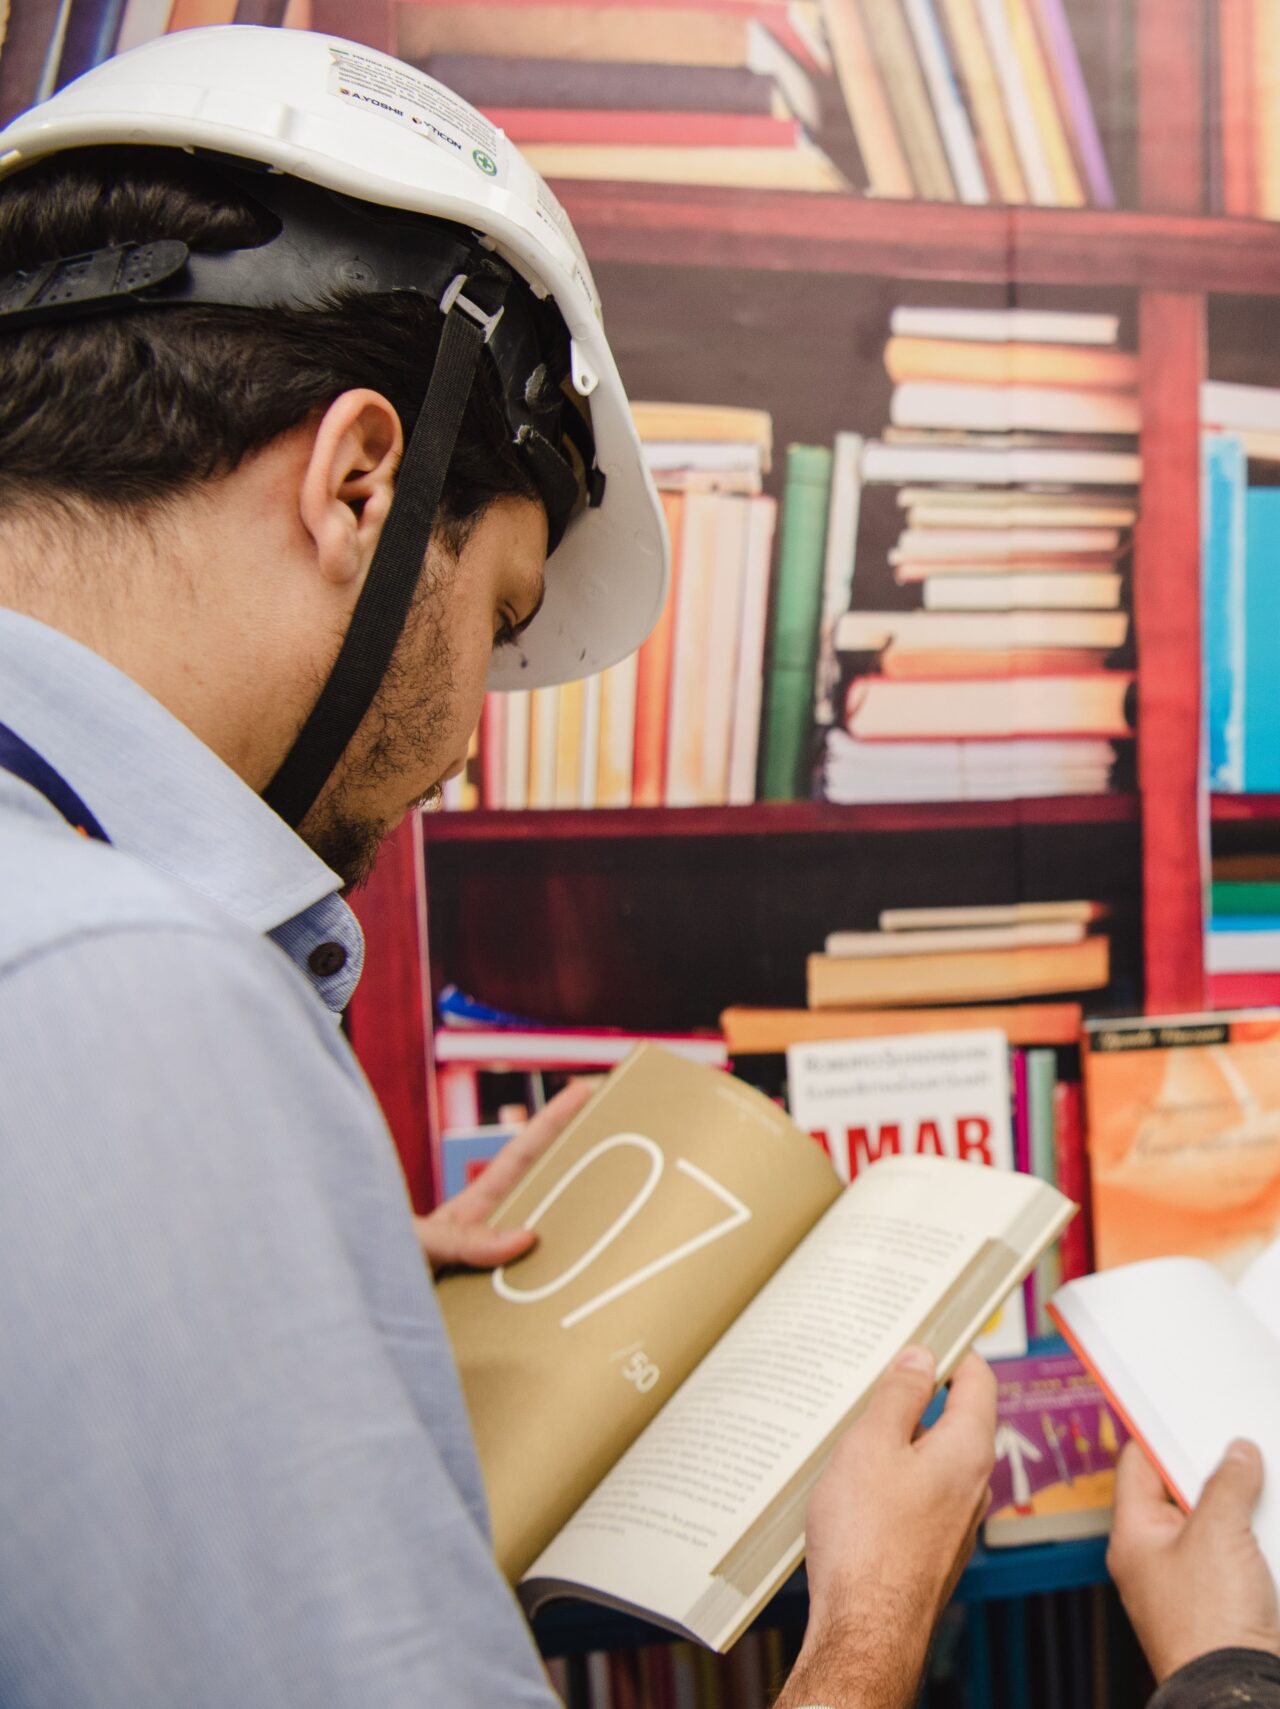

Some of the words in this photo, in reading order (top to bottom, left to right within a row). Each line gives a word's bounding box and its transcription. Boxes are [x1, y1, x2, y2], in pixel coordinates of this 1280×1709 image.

[352, 90, 404, 118] A.YOSHII
[423, 120, 463, 151] YTICON
[810, 1115, 994, 1183] MAR
[491, 1126, 753, 1329] 07
